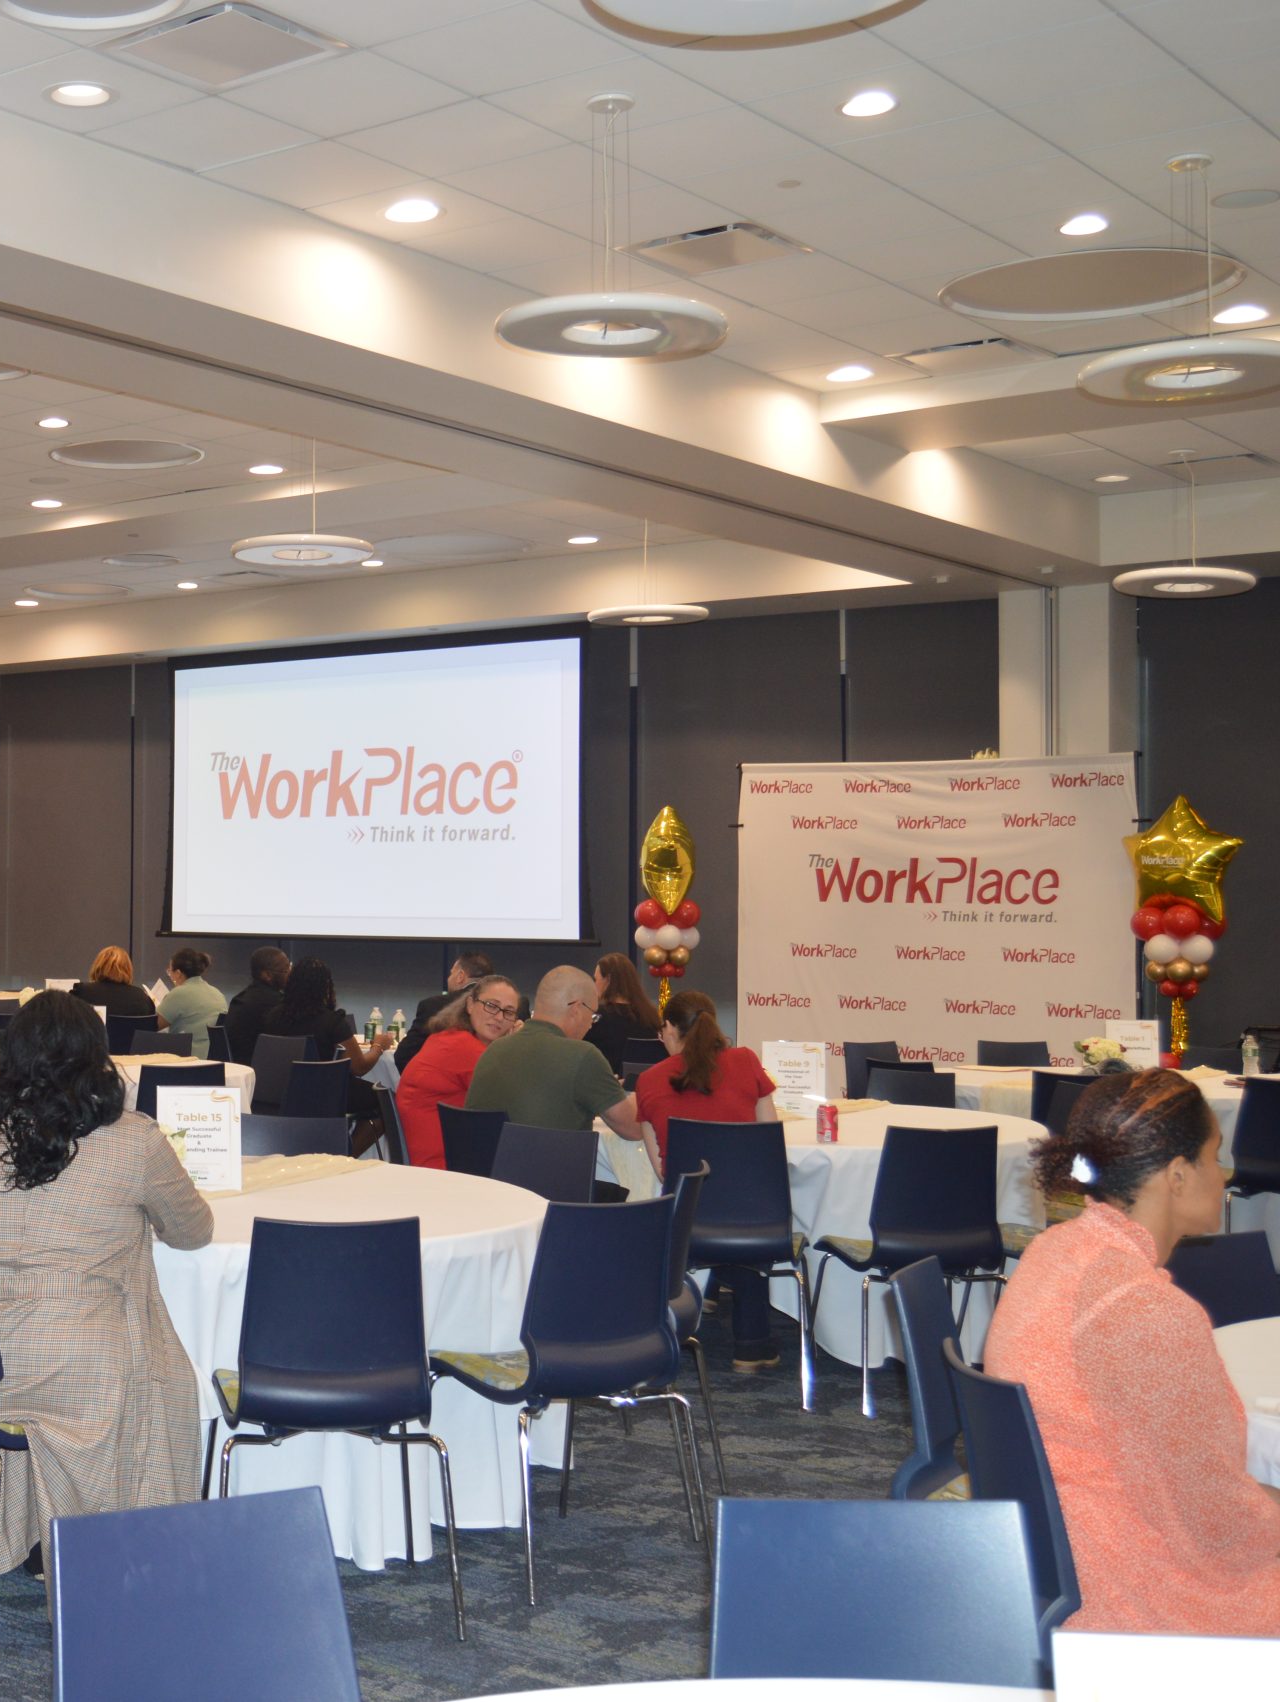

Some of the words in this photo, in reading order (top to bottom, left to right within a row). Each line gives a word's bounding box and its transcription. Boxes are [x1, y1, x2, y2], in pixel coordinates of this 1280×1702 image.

[210, 752, 240, 771] The
[218, 746, 518, 820] WorkPlace
[750, 780, 813, 794] WorkPlace
[844, 779, 912, 794] WorkPlace
[950, 776, 1020, 792] WorkPlace
[1051, 772, 1125, 789] WorkPlace
[792, 815, 858, 830] WorkPlace
[896, 815, 966, 830] WorkPlace
[1003, 812, 1076, 828] WorkPlace
[370, 825, 415, 843] Think
[422, 824, 436, 843] it
[441, 823, 517, 843] forward.
[808, 854, 834, 868] The
[815, 856, 1060, 906] WorkPlace
[941, 910, 978, 923] Think
[984, 911, 994, 923] it
[999, 911, 1058, 924] forward.
[791, 943, 857, 958] WorkPlace
[896, 946, 965, 961] WorkPlace
[1003, 948, 1076, 964] WorkPlace
[747, 993, 811, 1008] WorkPlace
[839, 996, 907, 1012] WorkPlace
[945, 999, 1016, 1016] WorkPlace
[1047, 1003, 1121, 1020] WorkPlace
[778, 1060, 802, 1068] Table
[176, 1113, 208, 1122] Table
[211, 1113, 223, 1122] 15
